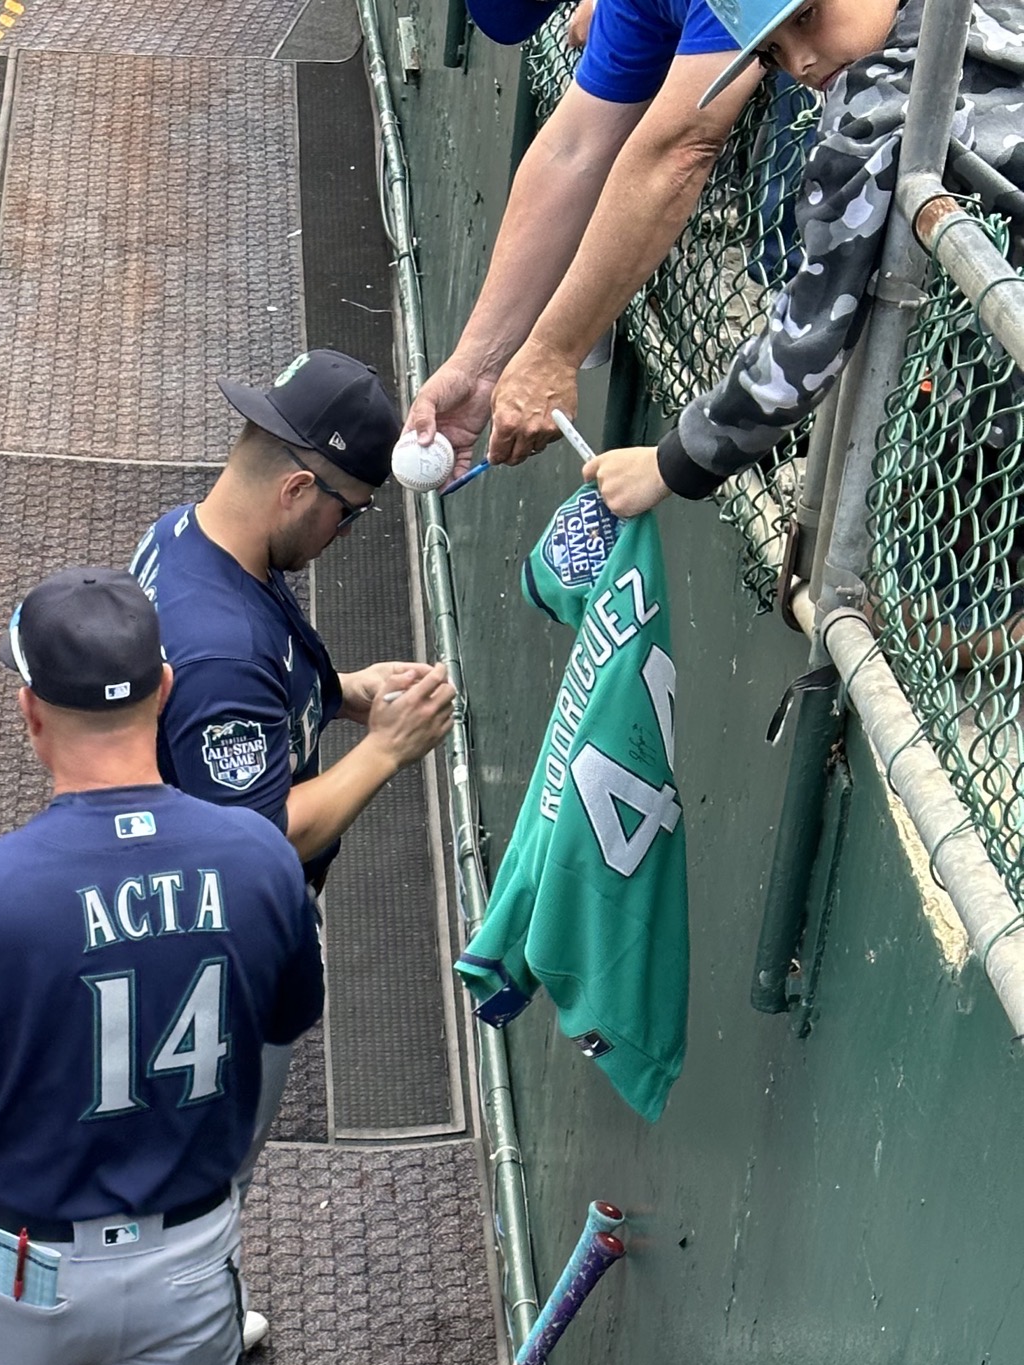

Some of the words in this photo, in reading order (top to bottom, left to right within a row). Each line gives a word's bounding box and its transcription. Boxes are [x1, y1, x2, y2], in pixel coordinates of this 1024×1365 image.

[567, 515, 590, 574] GAME
[586, 535, 608, 581] STA
[540, 566, 660, 823] RODRIGUEZ
[219, 753, 256, 770] GAME
[76, 868, 230, 954] ACTA
[78, 956, 232, 1122] 14
